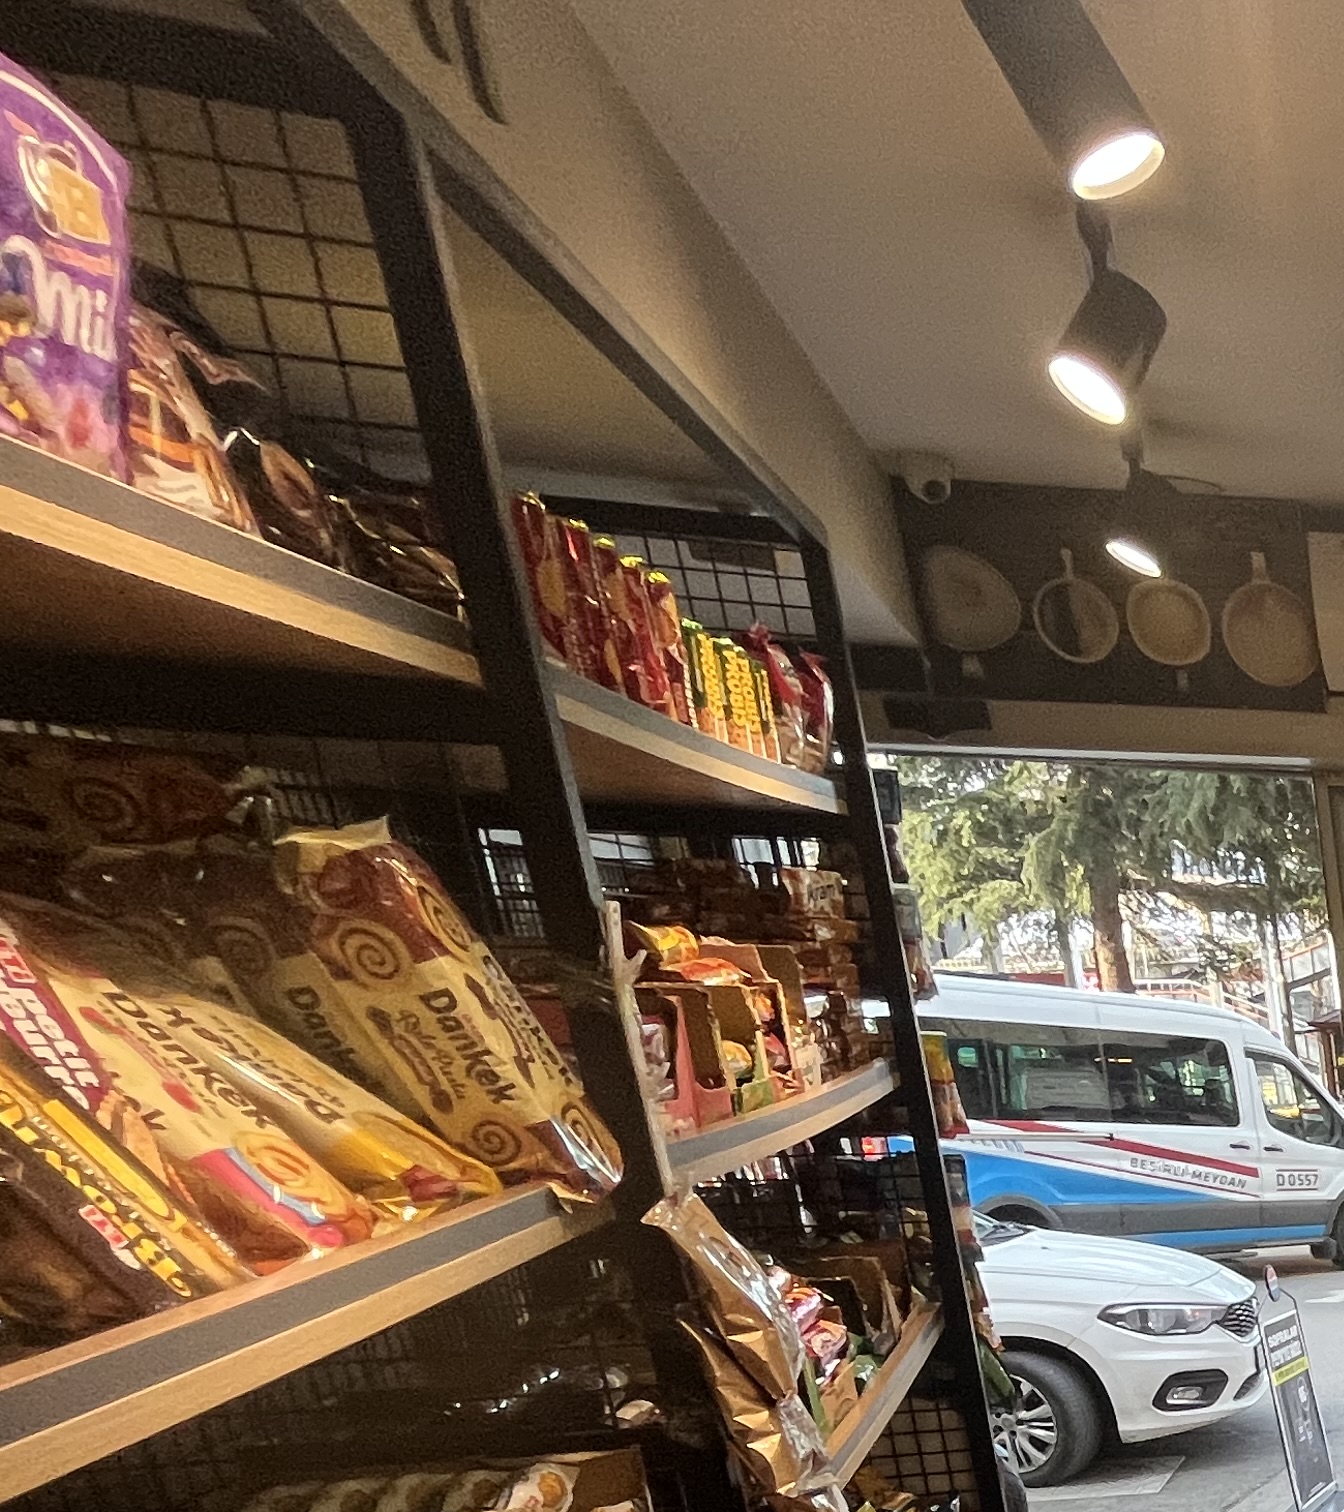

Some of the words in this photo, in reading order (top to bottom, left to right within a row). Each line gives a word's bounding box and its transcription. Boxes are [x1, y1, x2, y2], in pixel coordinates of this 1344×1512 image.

[21, 988, 101, 1089] petit
[104, 990, 277, 1132] Dankek
[418, 987, 517, 1105] Dankek
